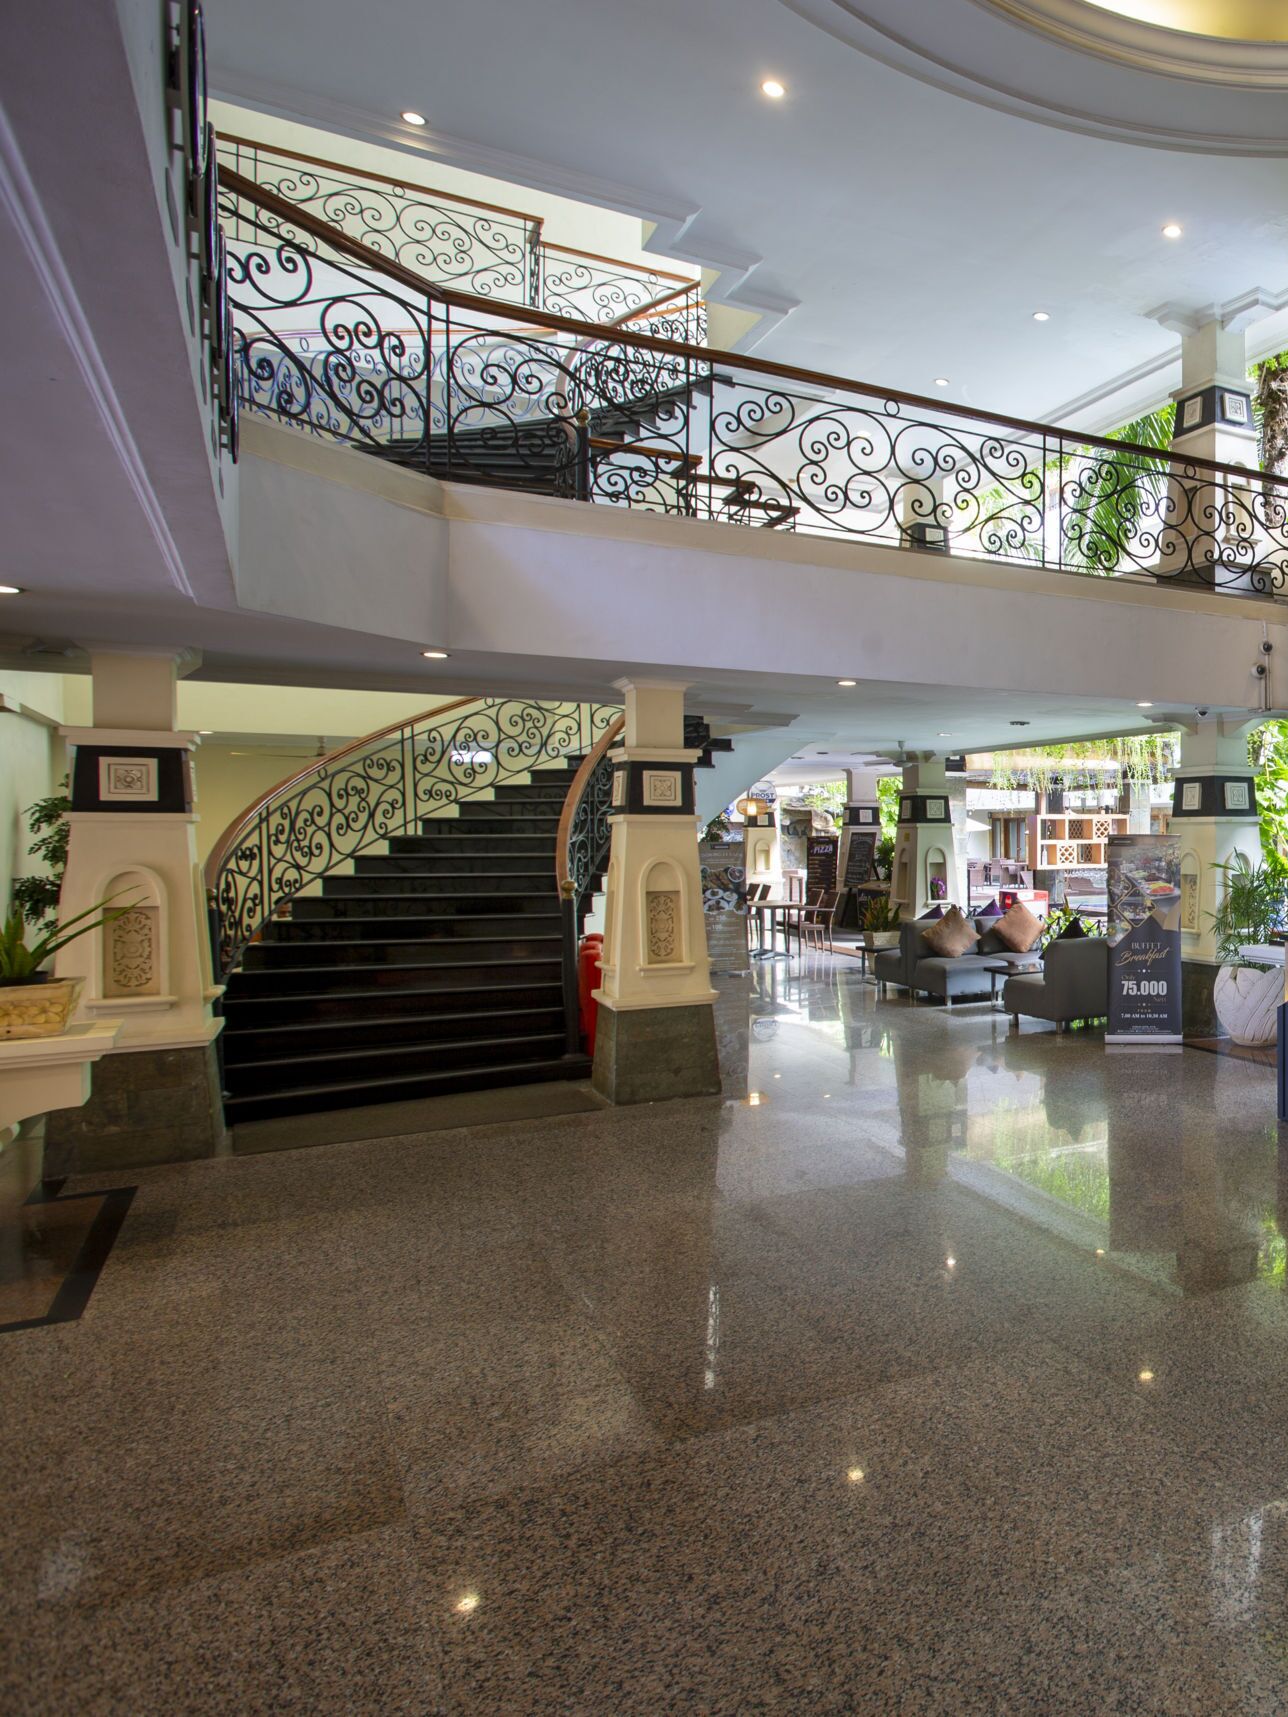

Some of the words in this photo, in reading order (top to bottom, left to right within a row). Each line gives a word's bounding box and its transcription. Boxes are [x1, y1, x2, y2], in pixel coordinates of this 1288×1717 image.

[813, 844, 833, 855] PIZZA
[1114, 947, 1170, 967] Breakfast
[1121, 980, 1168, 996] 75.000
